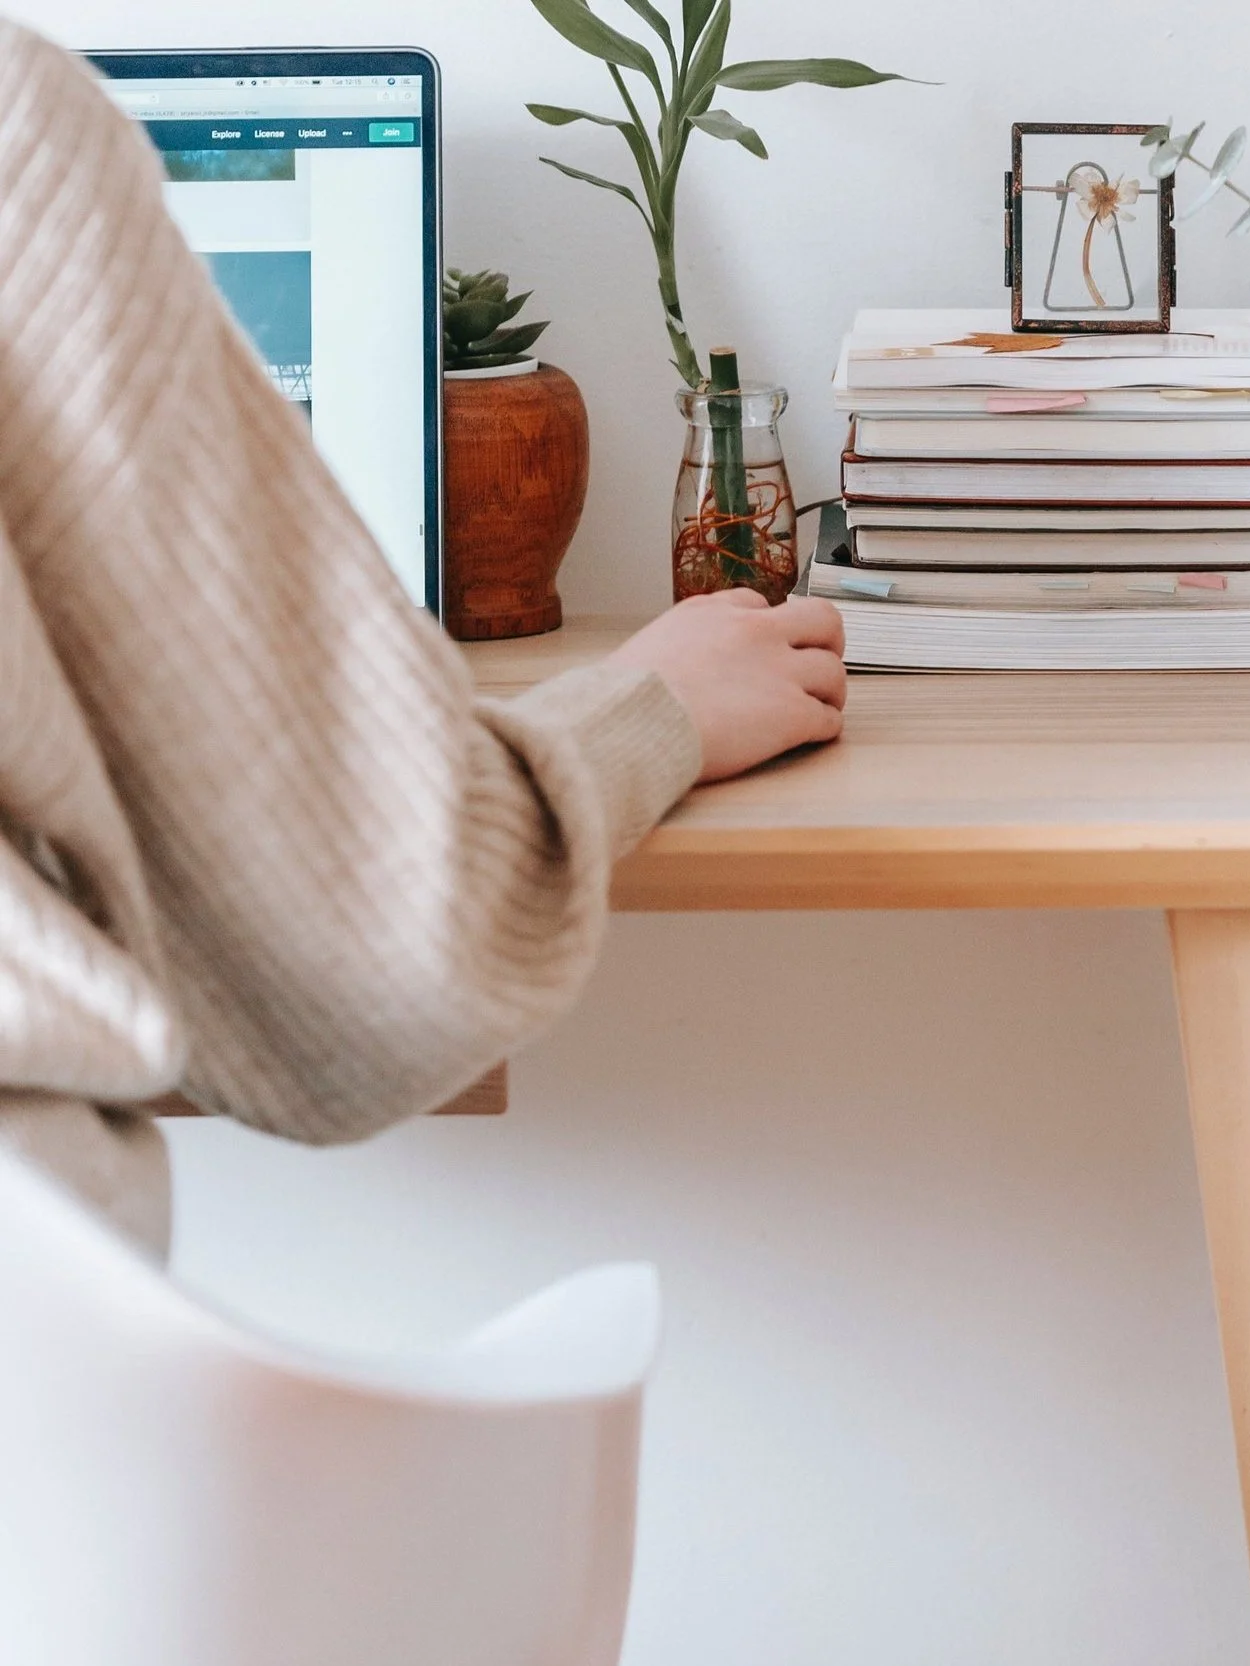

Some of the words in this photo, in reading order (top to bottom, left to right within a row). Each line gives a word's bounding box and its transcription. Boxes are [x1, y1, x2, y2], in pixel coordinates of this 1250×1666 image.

[211, 130, 241, 140] Explore
[254, 129, 285, 138] License
[298, 128, 327, 139] Upload
[382, 127, 400, 137] Join
